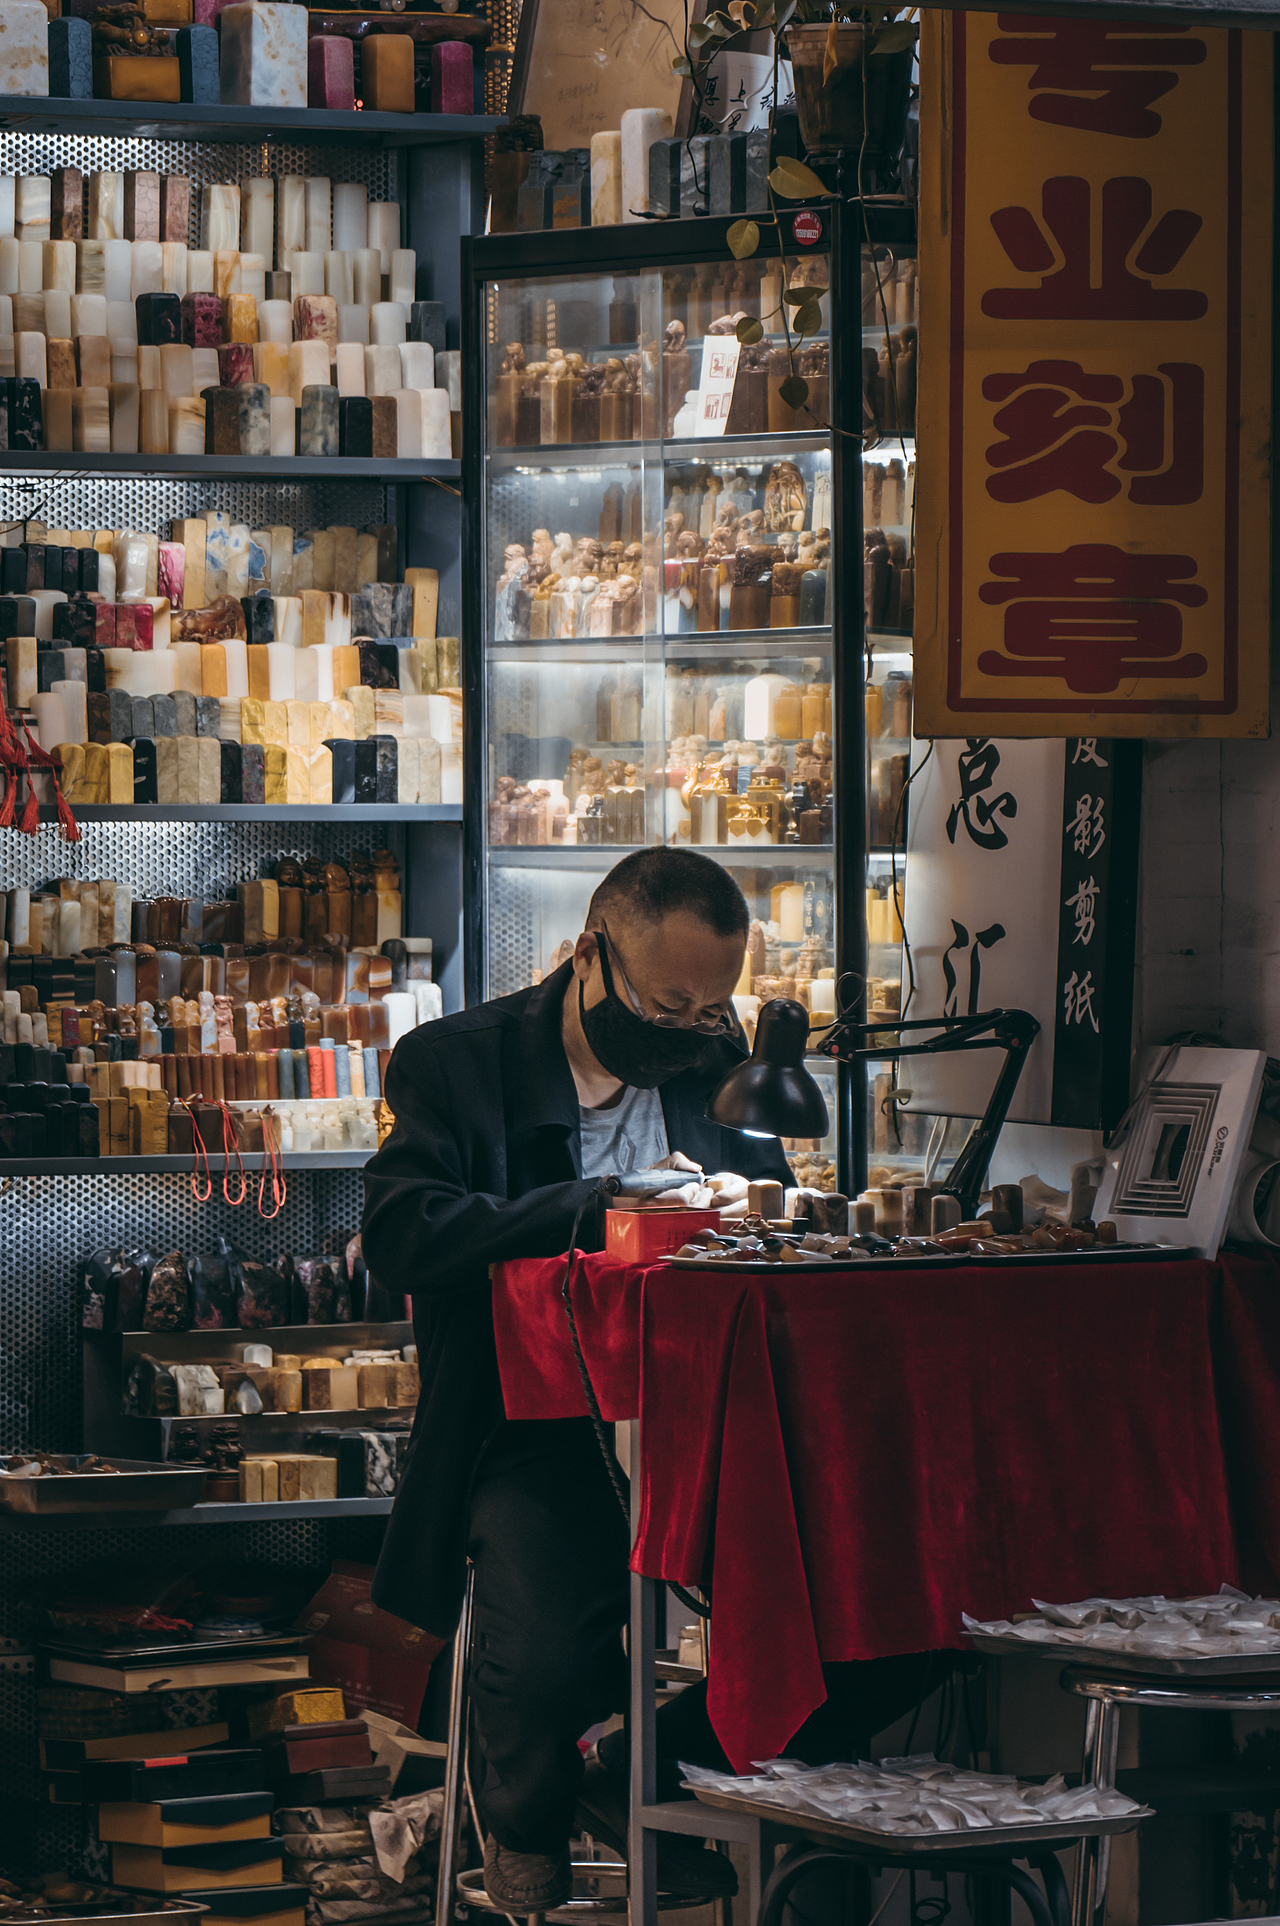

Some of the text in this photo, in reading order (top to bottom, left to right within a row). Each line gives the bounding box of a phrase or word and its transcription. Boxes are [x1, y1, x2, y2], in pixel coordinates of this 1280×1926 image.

[978, 13, 1208, 695] 专业刻章
[943, 738, 1018, 1033] 总汇
